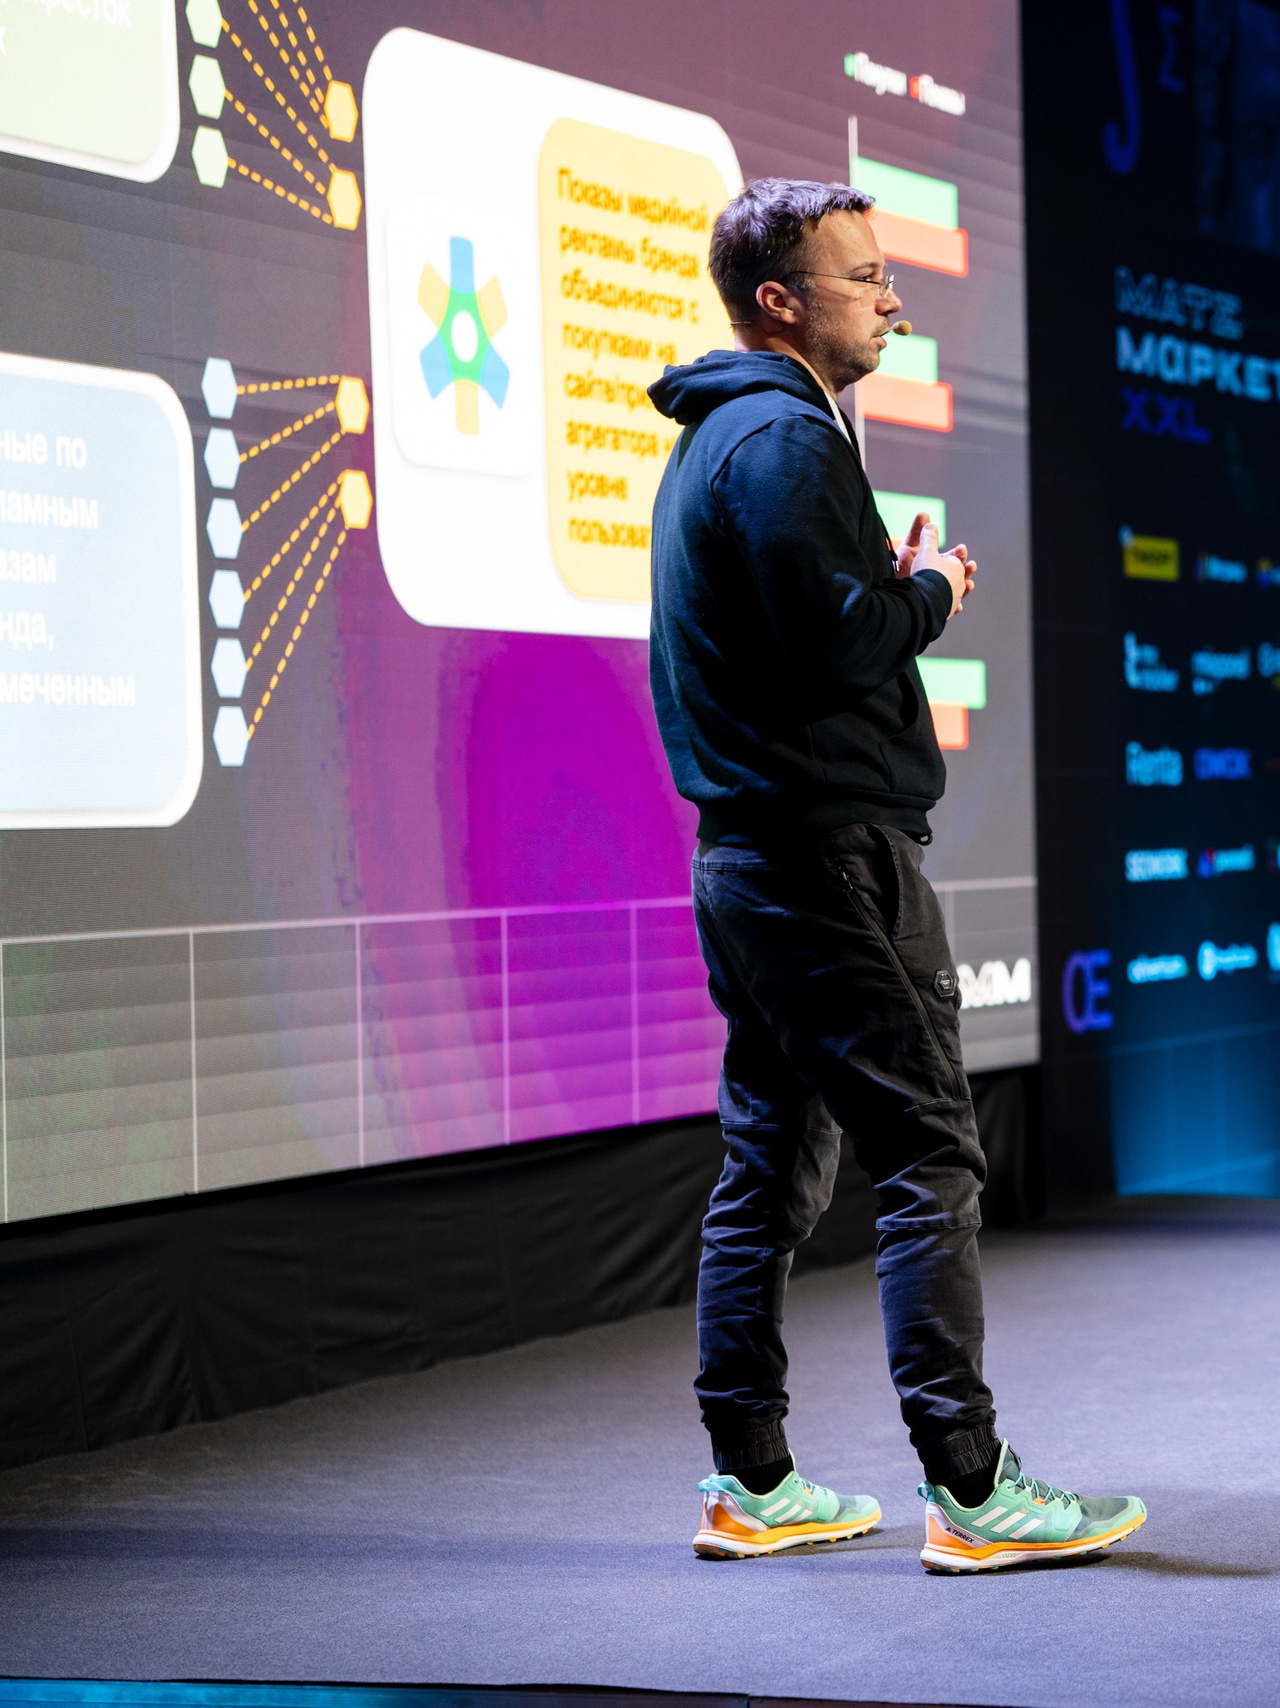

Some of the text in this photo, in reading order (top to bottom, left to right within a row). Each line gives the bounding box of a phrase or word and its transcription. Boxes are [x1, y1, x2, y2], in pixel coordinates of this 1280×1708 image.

[557, 166, 708, 234] Показы медийной
[559, 222, 699, 279] рекламы бренда
[561, 269, 698, 325] объединяются с
[562, 322, 677, 367] покупками на
[1121, 386, 1212, 444] XXL
[55, 435, 87, 470] по
[566, 419, 658, 462] агрегатора
[566, 469, 628, 503] уровне
[951, 1529, 975, 1543] TERREX
